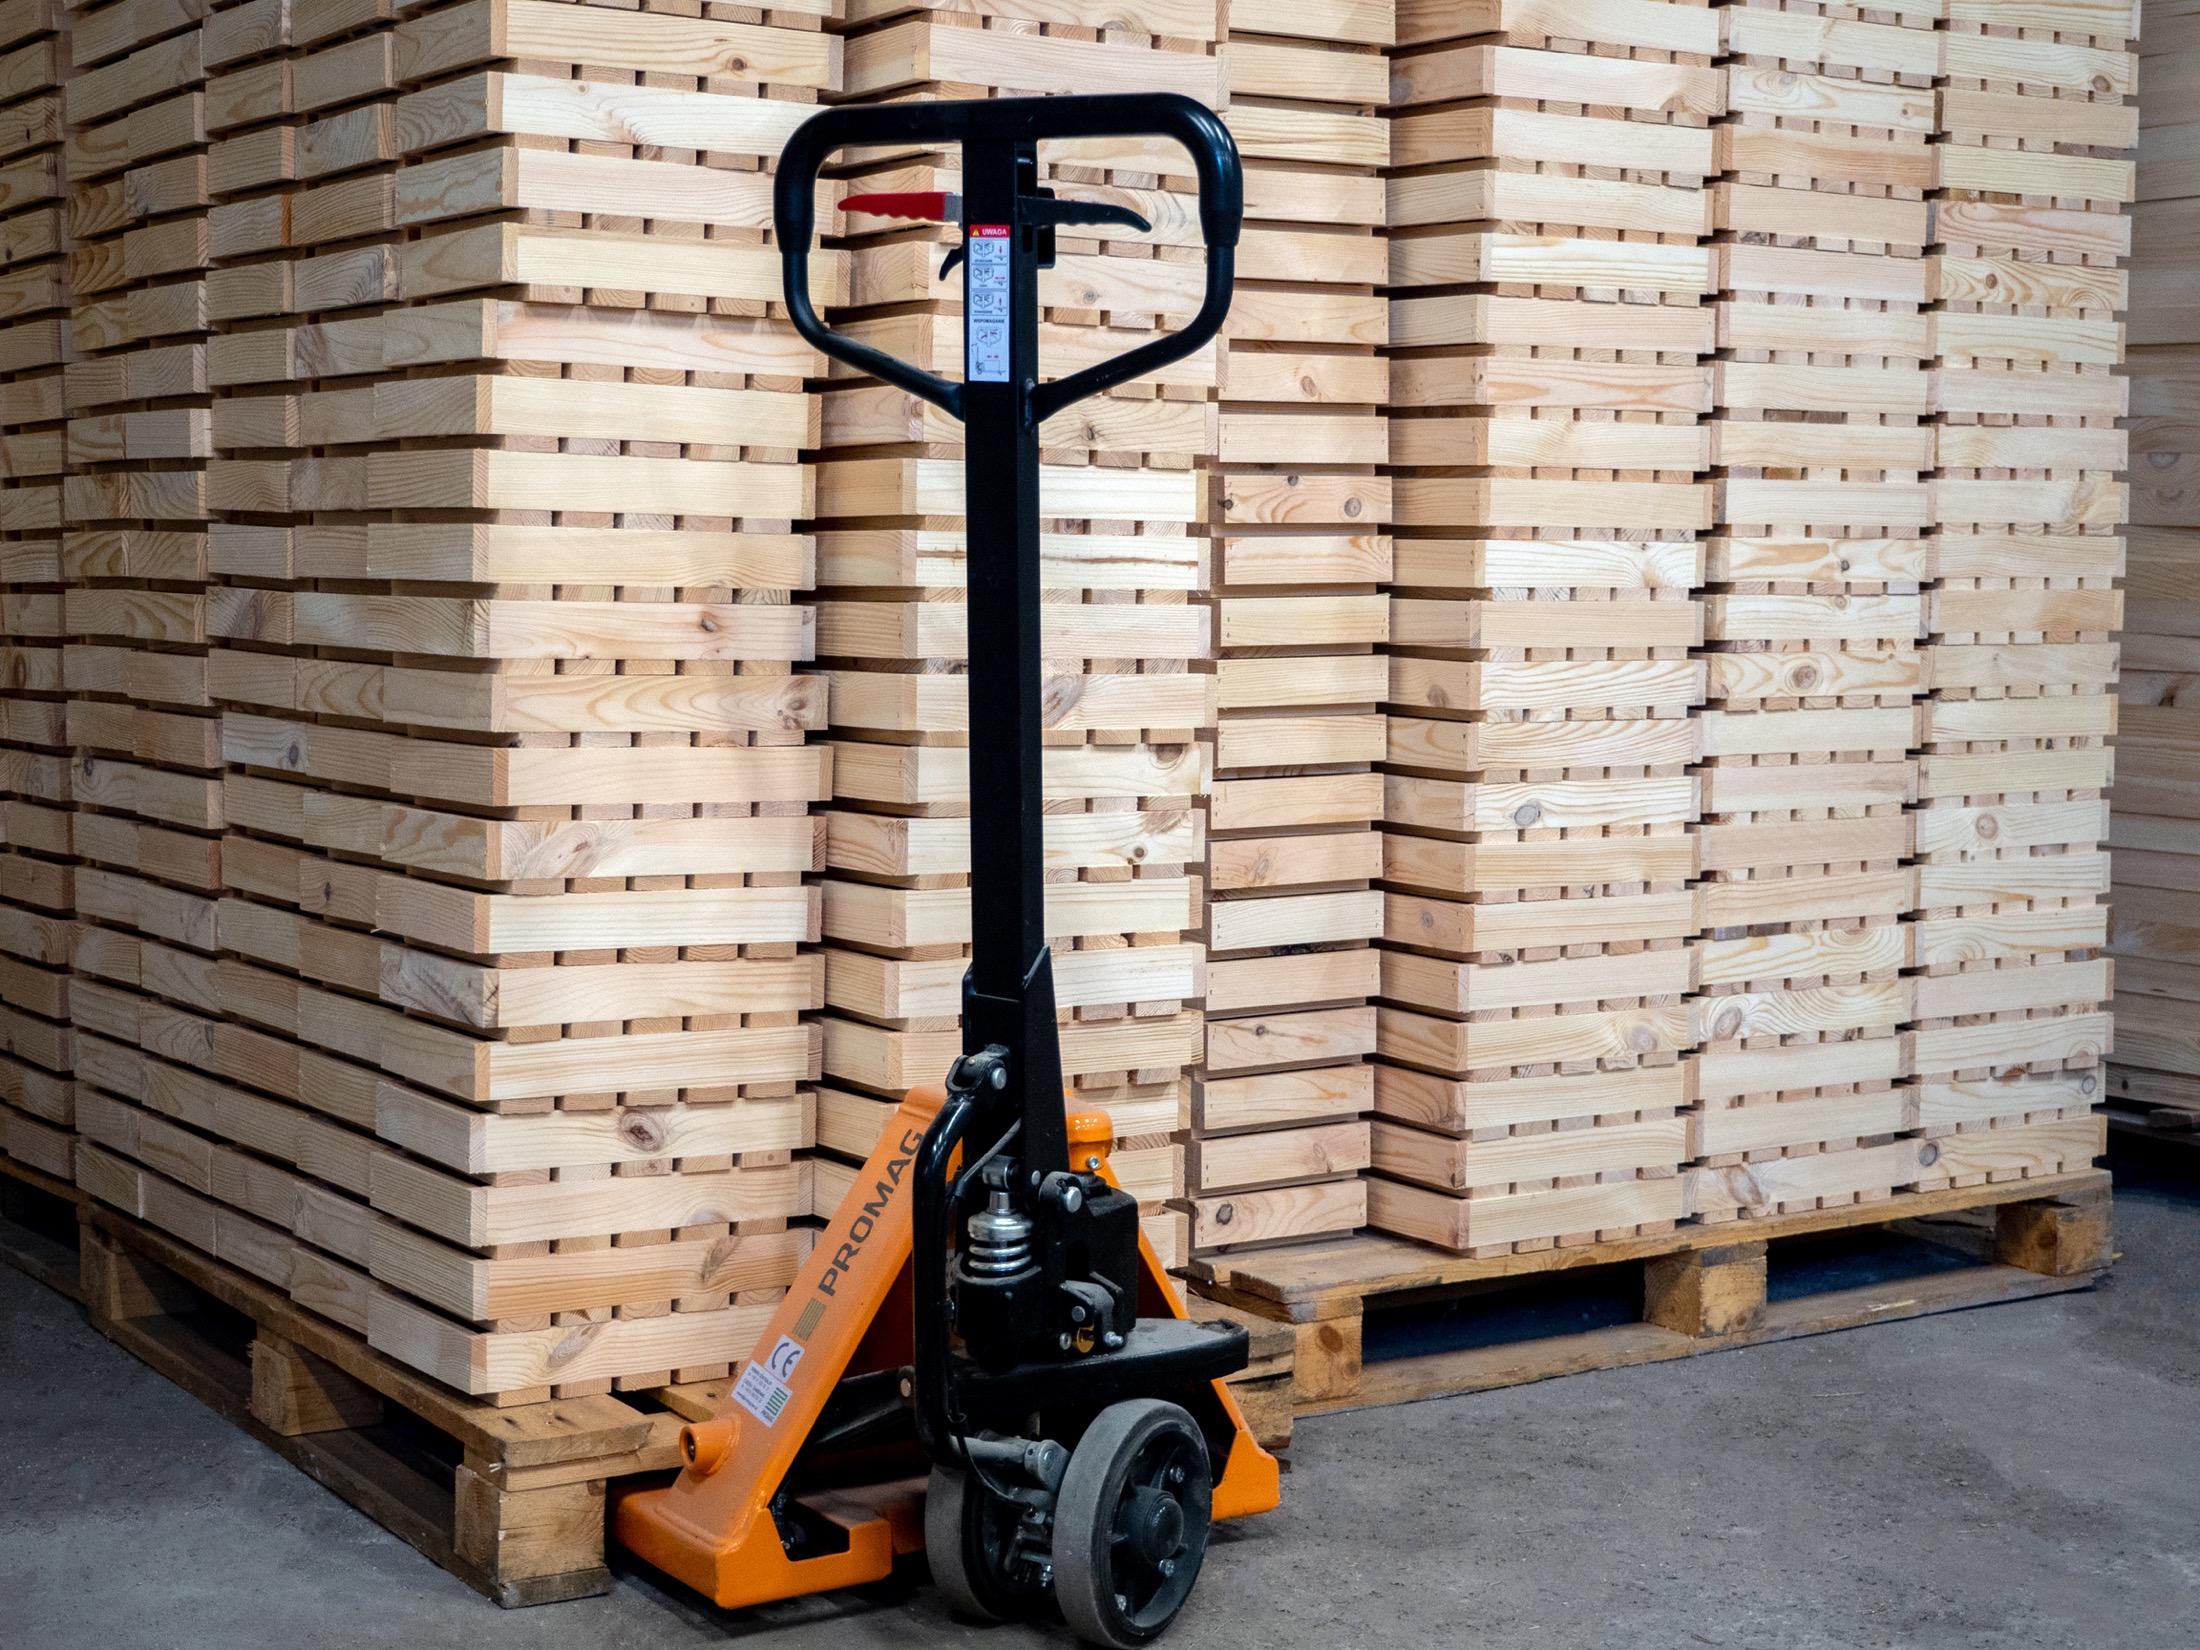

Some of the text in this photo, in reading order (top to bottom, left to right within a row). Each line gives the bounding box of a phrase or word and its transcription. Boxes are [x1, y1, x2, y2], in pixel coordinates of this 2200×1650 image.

[982, 228, 1007, 236] UWAGA
[818, 1128, 924, 1297] PROMAG
[771, 1342, 801, 1378] CE
